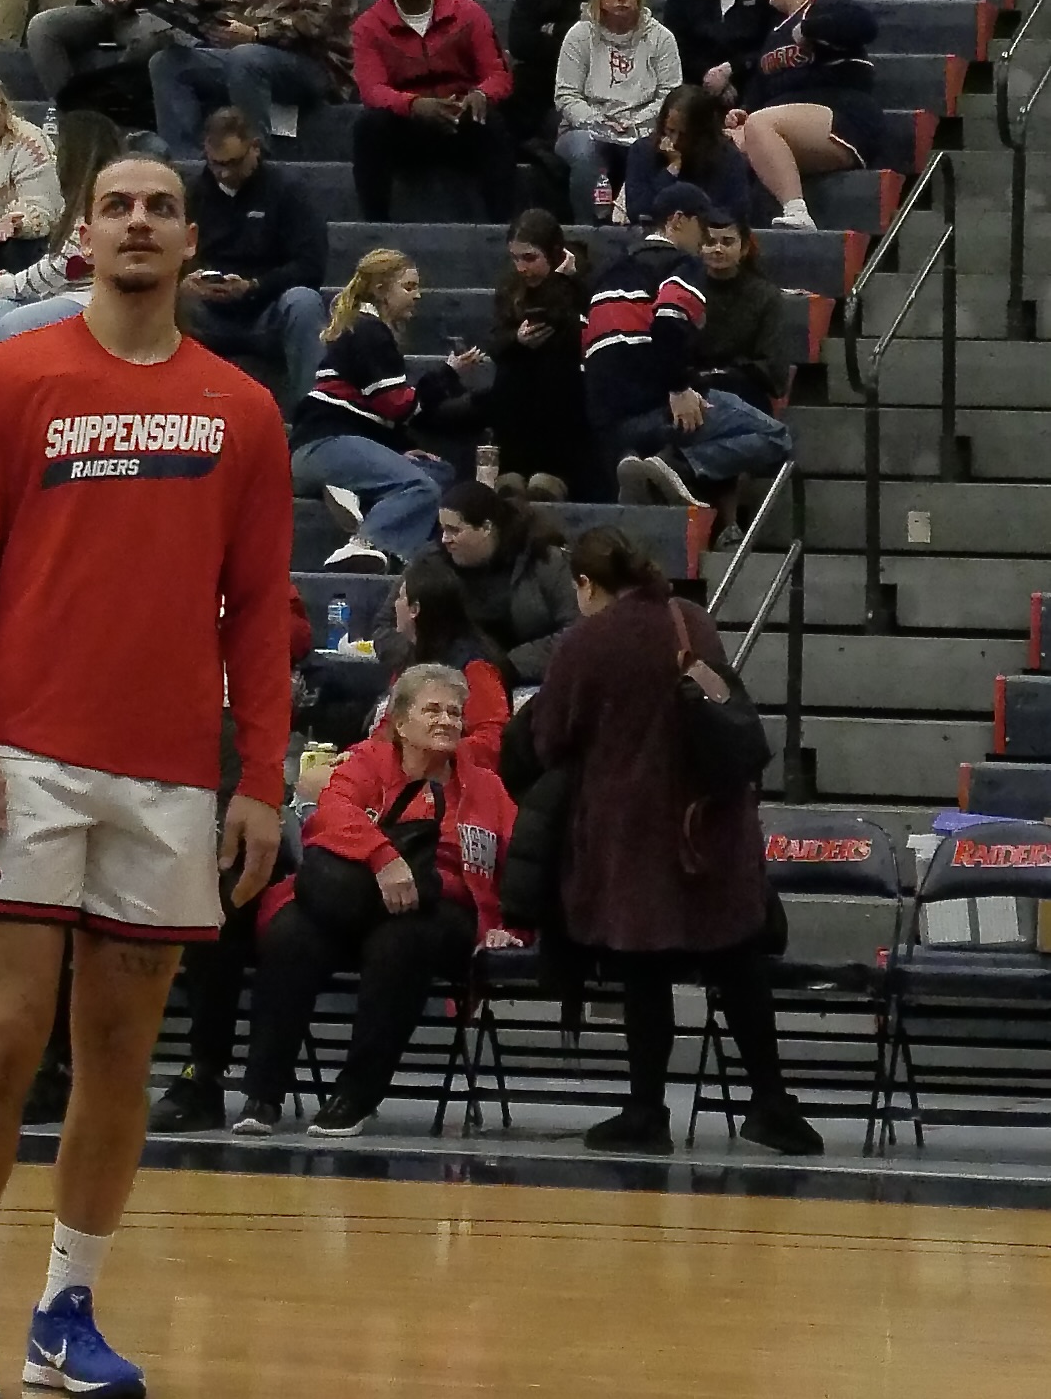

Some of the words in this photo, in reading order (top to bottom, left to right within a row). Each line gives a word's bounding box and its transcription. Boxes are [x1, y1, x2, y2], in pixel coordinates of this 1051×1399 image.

[44, 414, 226, 458] SHIPPENSBURG
[71, 458, 140, 479] RAIDERS
[765, 834, 873, 862] RAIDERS
